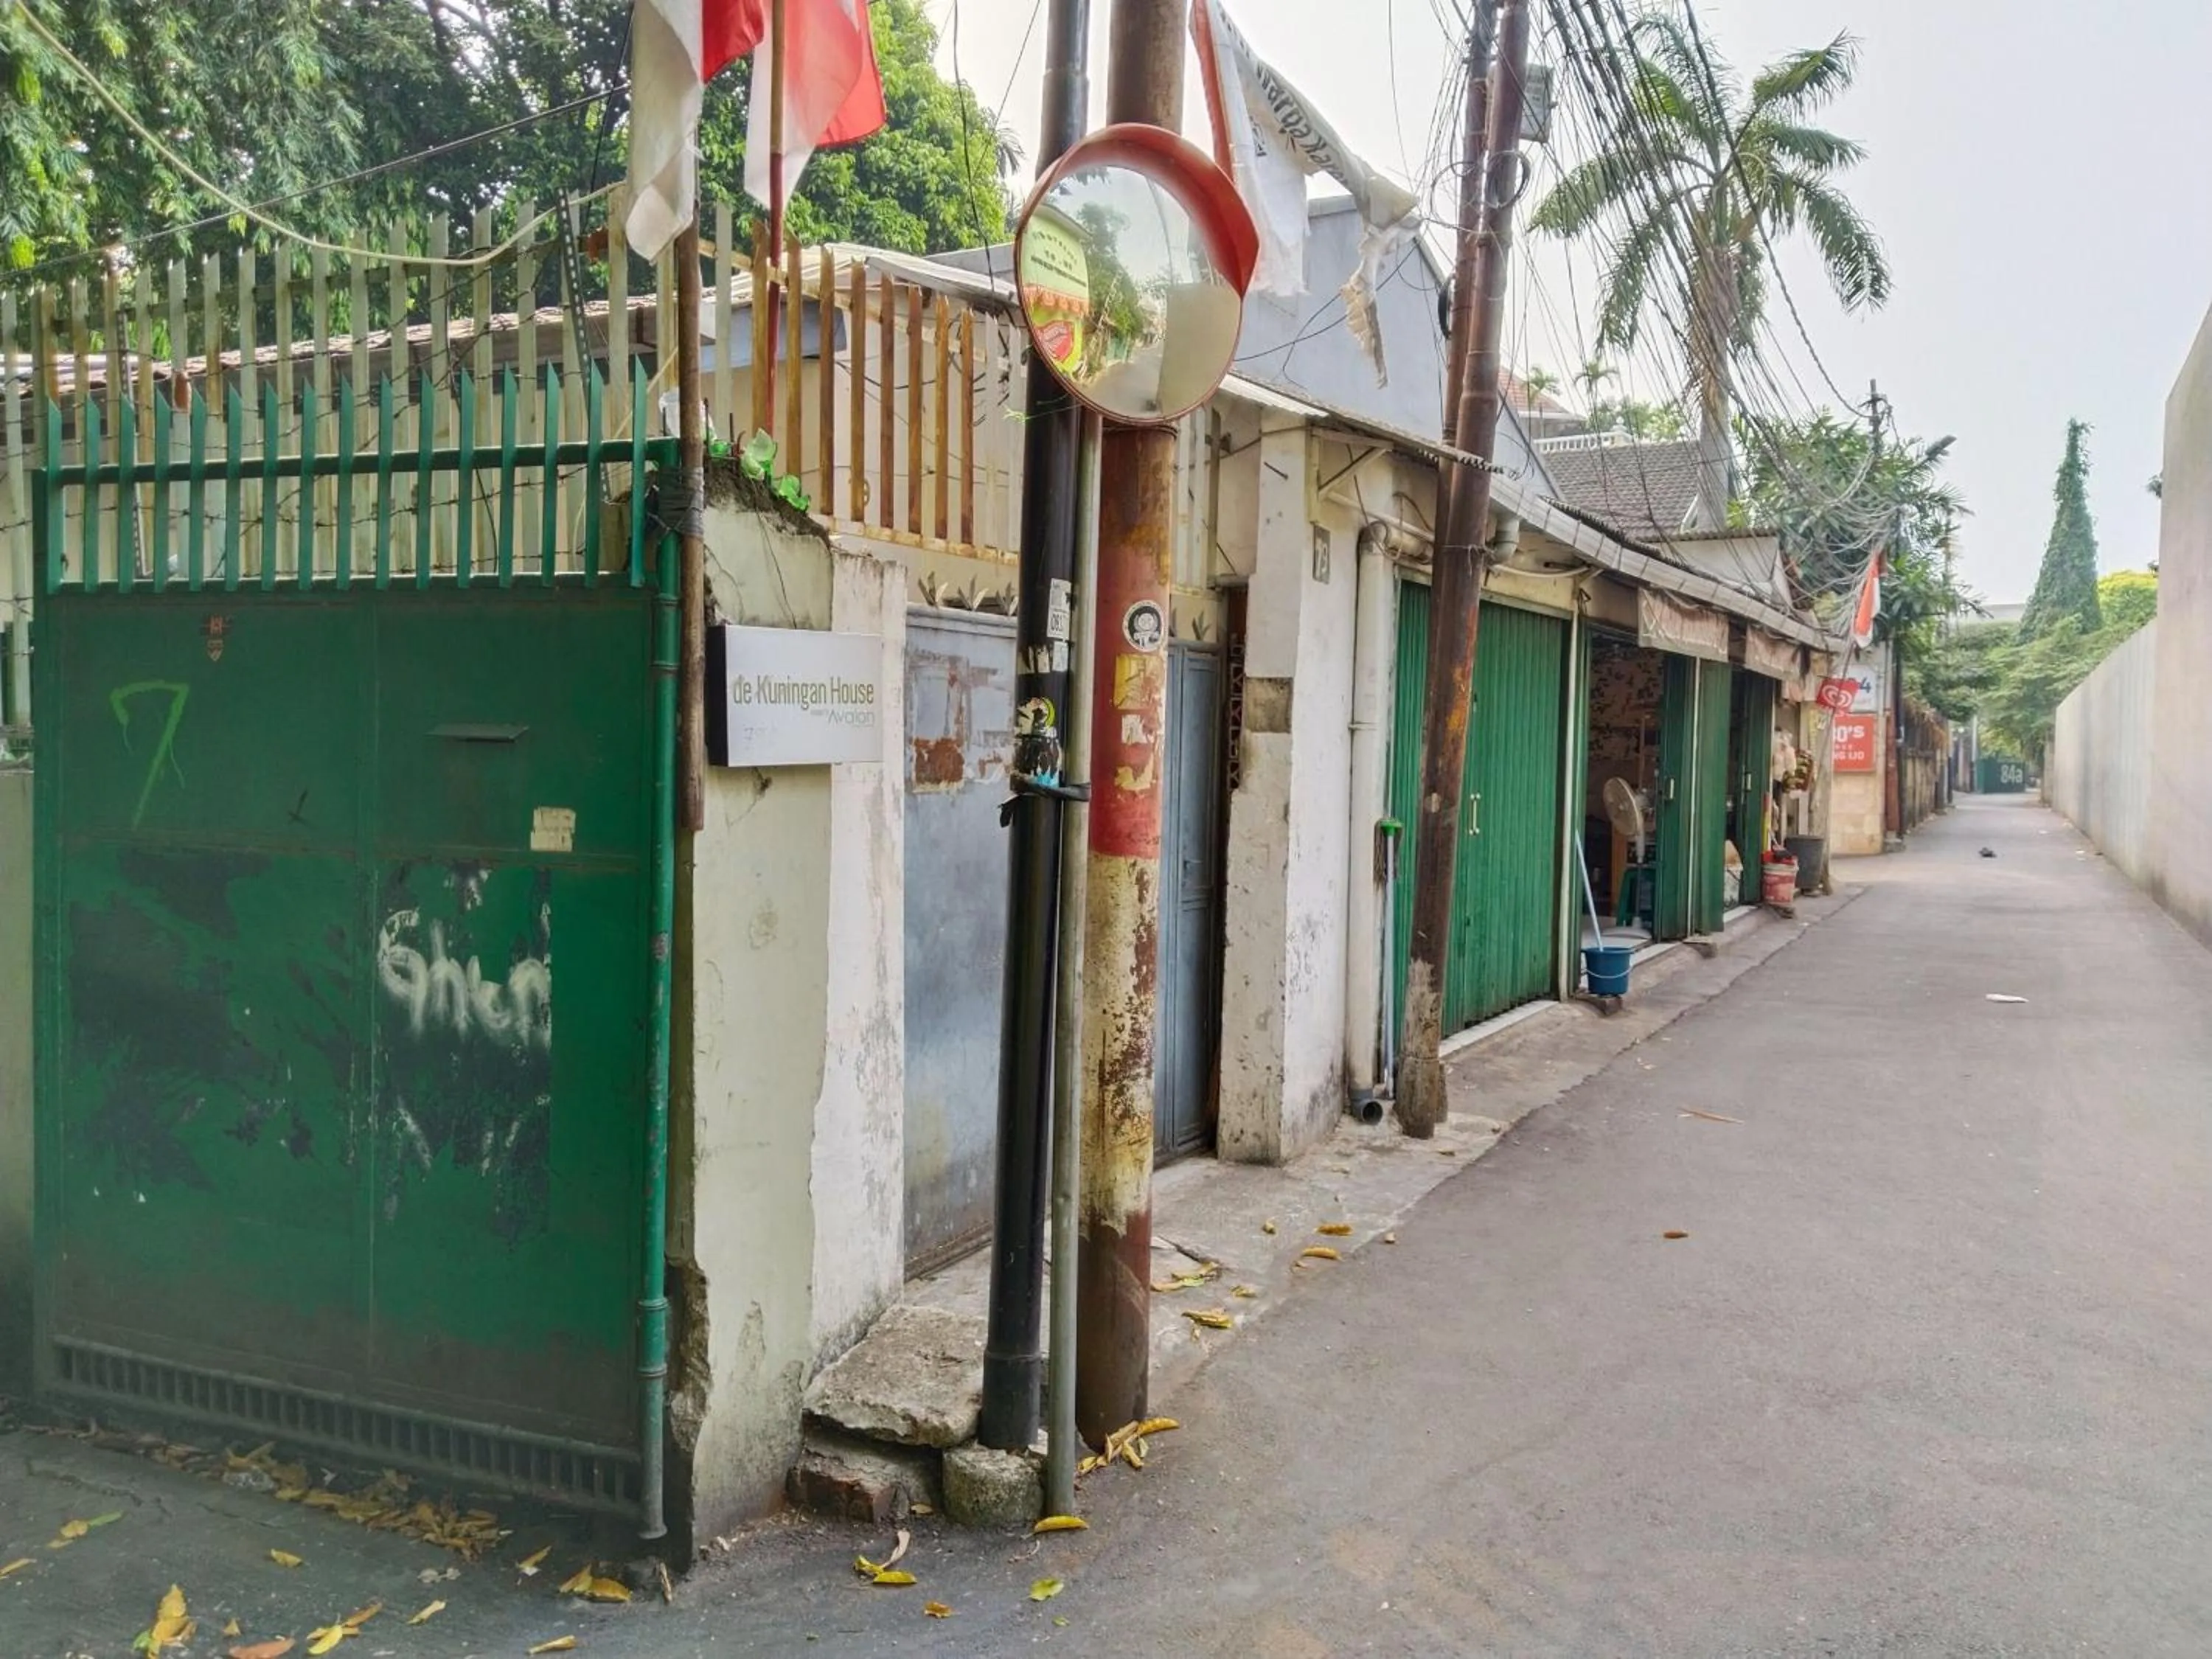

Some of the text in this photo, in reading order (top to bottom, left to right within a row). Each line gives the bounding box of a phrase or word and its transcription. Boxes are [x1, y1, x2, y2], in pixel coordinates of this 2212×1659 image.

[733, 674, 874, 710] de Kuningan House
[827, 709, 876, 726] Avalon
[2000, 764, 2023, 784] 84a
